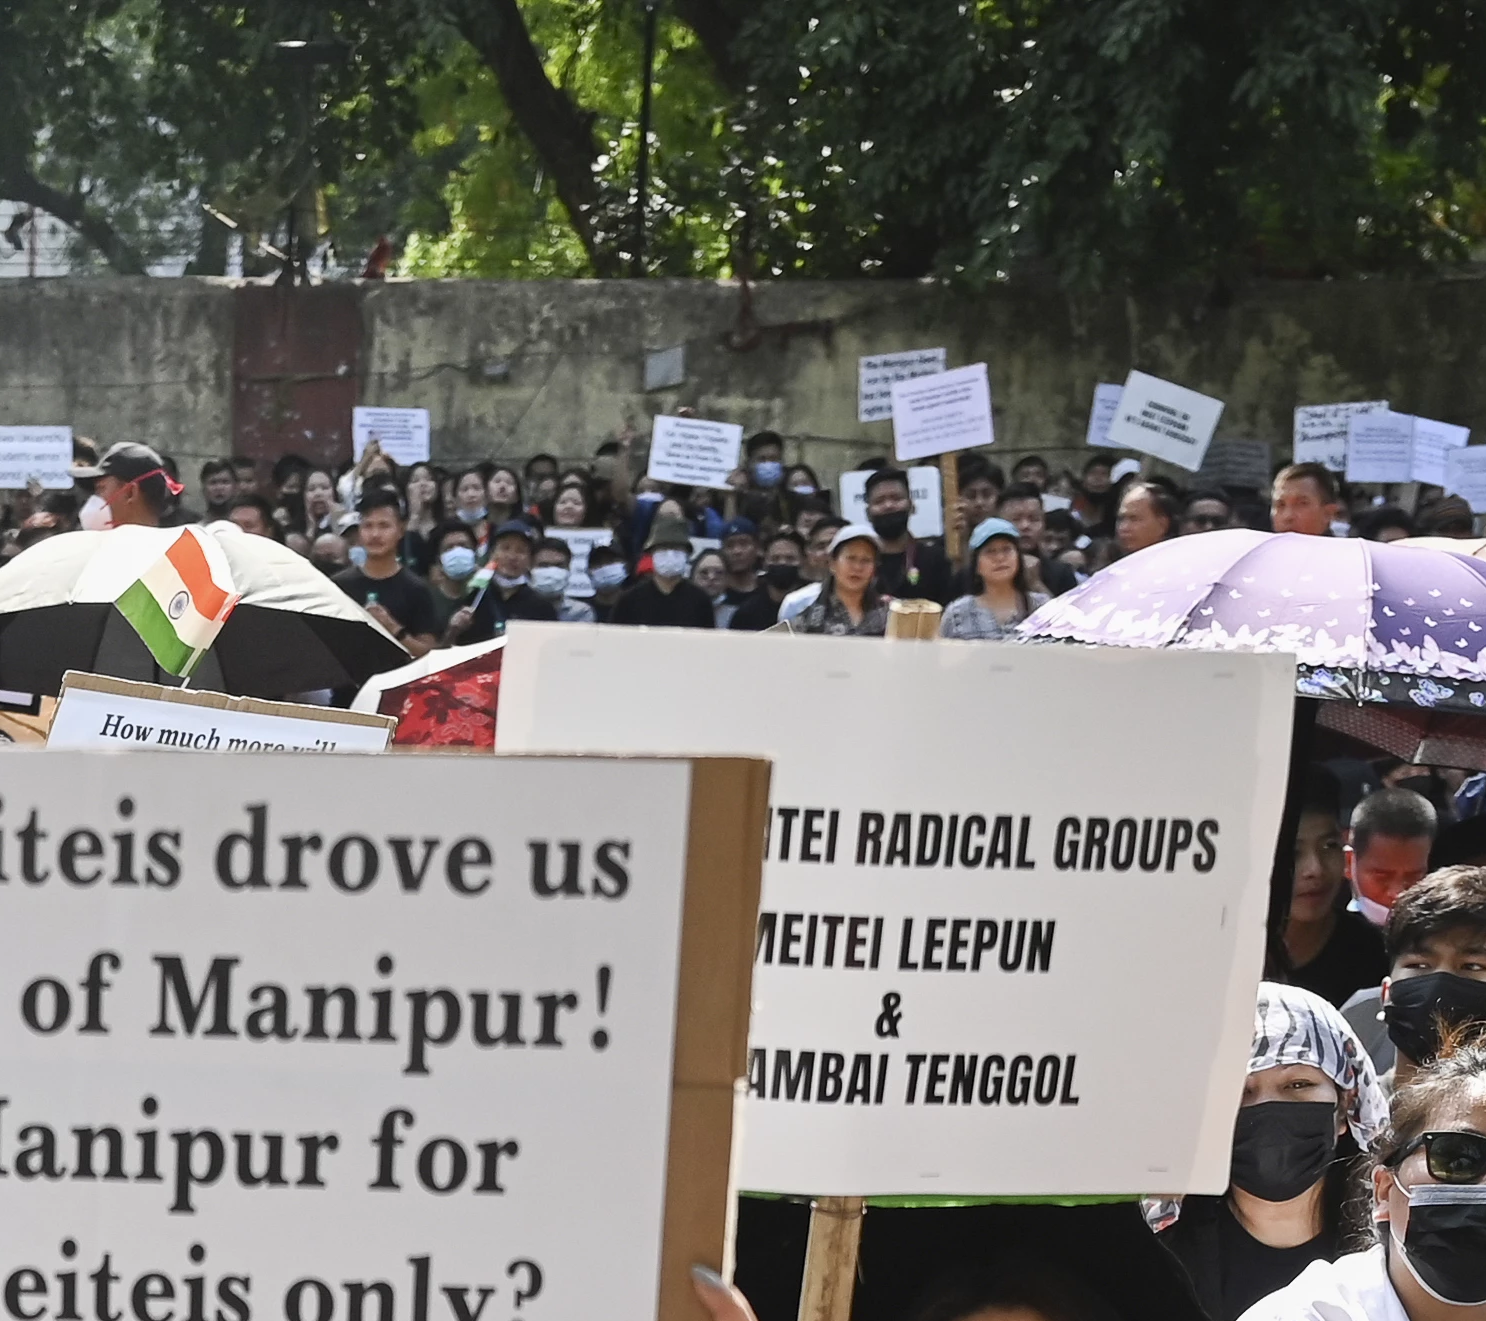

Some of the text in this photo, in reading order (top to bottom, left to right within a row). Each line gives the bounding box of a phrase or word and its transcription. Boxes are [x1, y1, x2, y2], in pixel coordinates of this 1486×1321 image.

[99, 713, 154, 742] How
[153, 727, 221, 753] much
[214, 803, 493, 897] drove
[528, 839, 631, 900] us
[855, 811, 1220, 874] RADICAL GROUPS
[898, 917, 1056, 973] LEEPUN
[20, 951, 122, 1035] of
[149, 953, 612, 1076] Manipur!
[874, 991, 903, 1039] &
[905, 1053, 1080, 1106] TENGGOL
[368, 1107, 520, 1195] for
